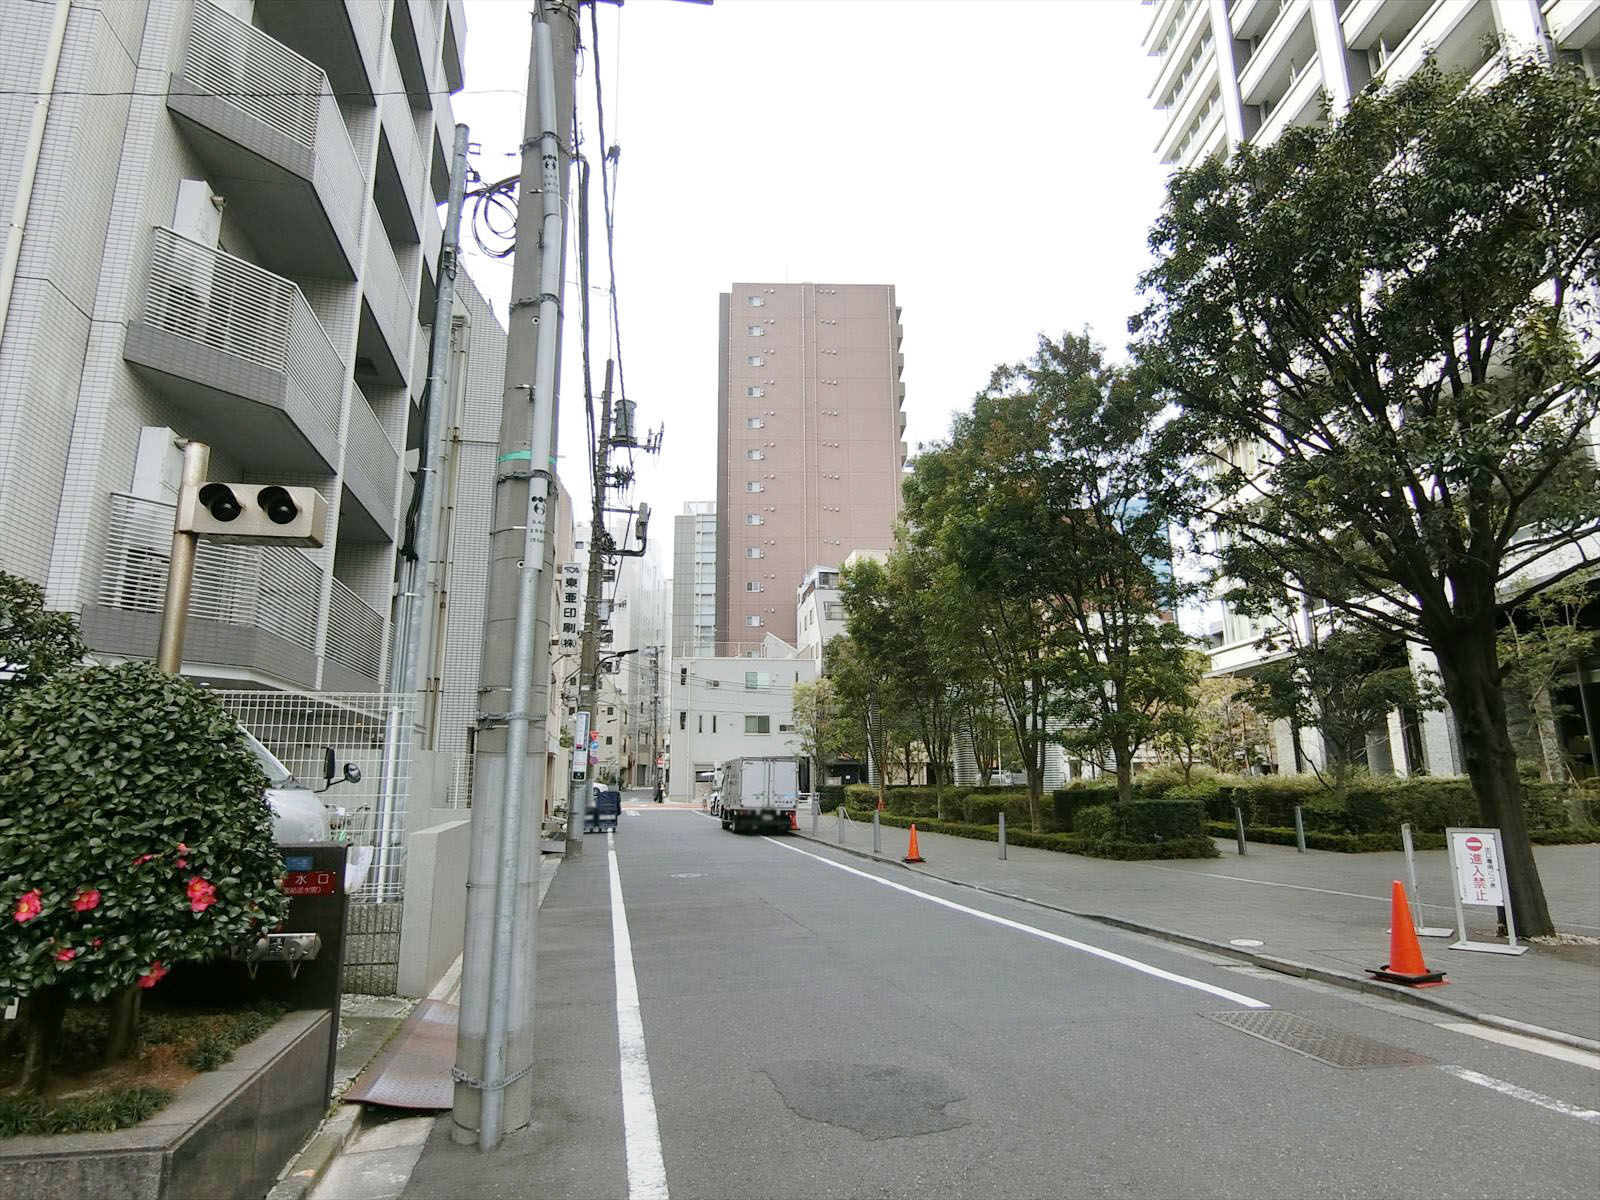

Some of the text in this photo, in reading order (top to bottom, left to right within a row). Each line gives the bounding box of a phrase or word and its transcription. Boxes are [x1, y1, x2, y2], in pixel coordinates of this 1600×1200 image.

[560, 577, 578, 648] 東亜印刷(株)
[1469, 853, 1489, 902] 進入禁止
